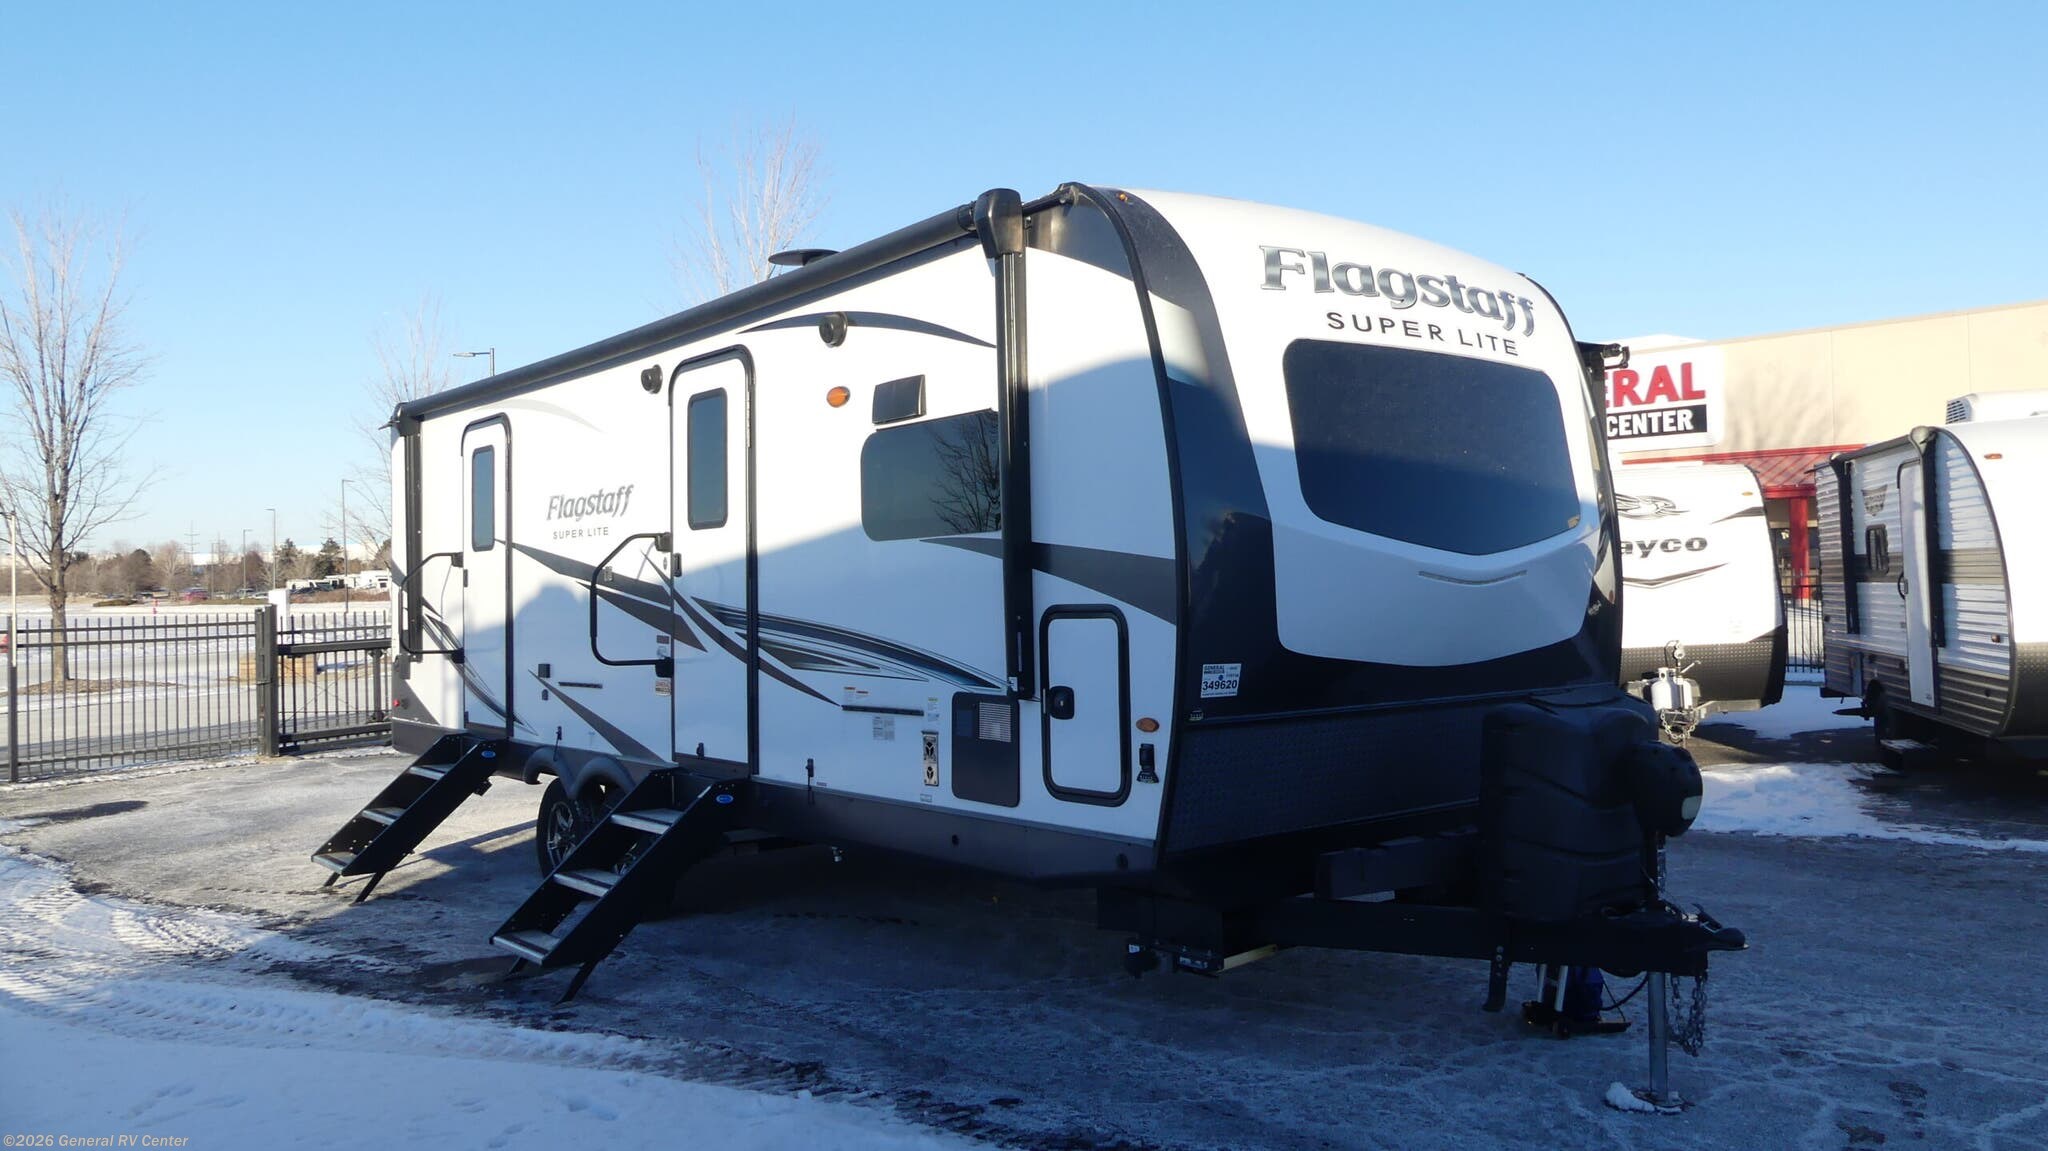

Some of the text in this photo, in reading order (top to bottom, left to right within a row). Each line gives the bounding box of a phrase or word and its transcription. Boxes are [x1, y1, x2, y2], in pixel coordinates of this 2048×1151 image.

[1259, 245, 1535, 337] Flagstaff
[1326, 311, 1519, 356] SUPER LITE
[1605, 362, 1706, 408] RAL
[1607, 408, 1694, 437] CENTER
[546, 484, 634, 522] Flagstaff
[553, 526, 609, 540] SUPER LITE
[1202, 680, 1238, 691] 349620
